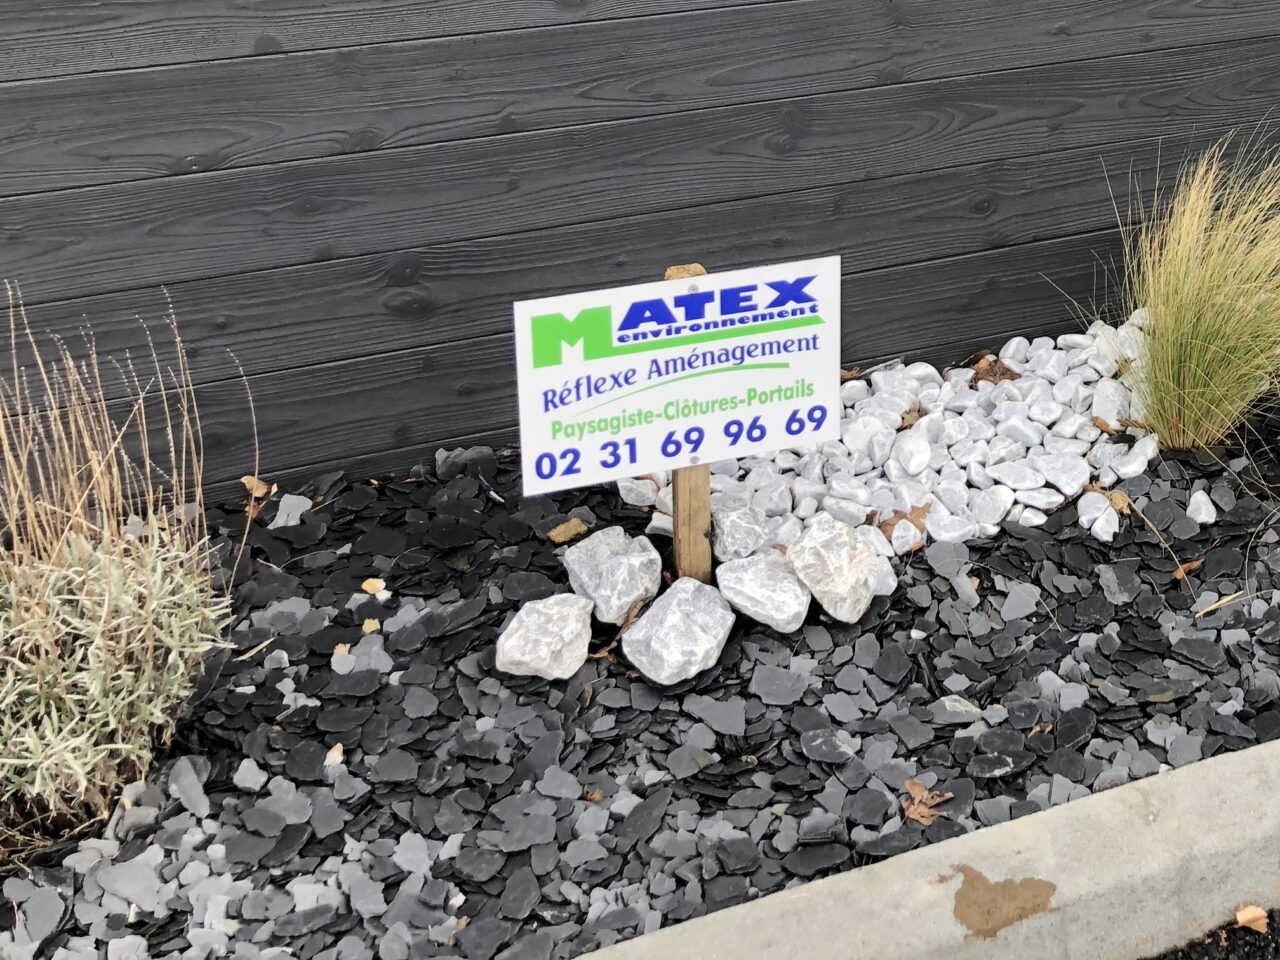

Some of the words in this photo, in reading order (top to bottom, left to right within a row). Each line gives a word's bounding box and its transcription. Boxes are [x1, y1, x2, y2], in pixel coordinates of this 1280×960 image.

[531, 275, 818, 369] MATEX
[617, 304, 819, 343] environnement
[542, 367, 637, 413] Réflexe
[647, 334, 820, 380] Aménagement
[535, 447, 581, 480] 02
[600, 438, 637, 469] 31
[661, 426, 705, 458] 69
[723, 415, 767, 446] 96
[785, 405, 828, 436] 69
